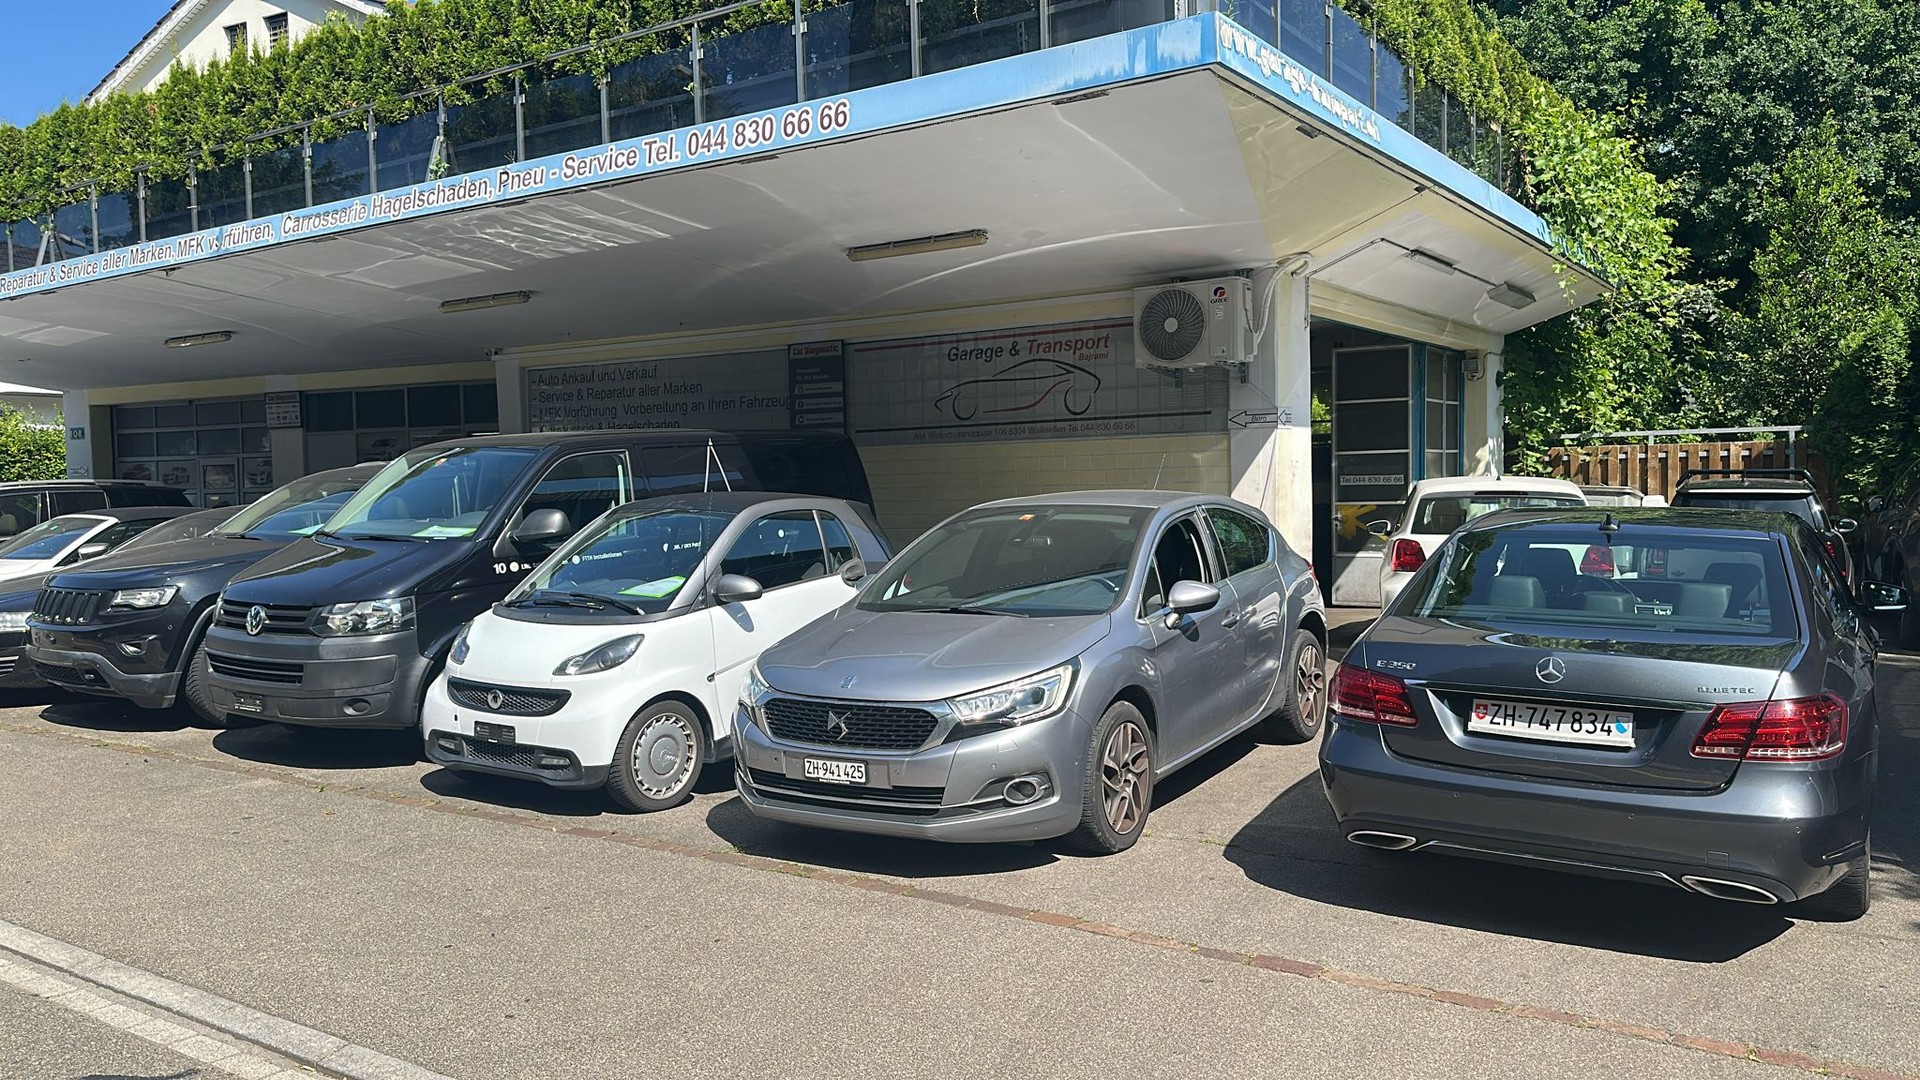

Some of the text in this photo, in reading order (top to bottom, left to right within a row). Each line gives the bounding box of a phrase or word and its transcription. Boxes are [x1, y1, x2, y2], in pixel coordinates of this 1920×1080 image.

[0, 269, 47, 294] Reparatur
[49, 268, 57, 283] &
[60, 260, 98, 281] Service
[102, 252, 127, 272] aller
[129, 245, 175, 266] Marken,
[177, 235, 204, 258] MFK
[208, 222, 274, 251] vrführen,
[283, 205, 366, 235] Carrosserie
[371, 179, 493, 218] Hagelschaden,
[498, 167, 544, 192] Pneu
[563, 148, 637, 179] Service
[644, 138, 679, 165] Tel.
[688, 126, 726, 156] 044
[734, 116, 774, 147] 830
[783, 109, 810, 137] 66
[819, 101, 848, 131] 66
[947, 333, 1110, 362] Garage & Transport
[538, 374, 560, 386] Auto
[561, 370, 595, 385] Ankauf
[597, 369, 616, 382] und
[618, 365, 658, 380] Verkauf
[539, 390, 574, 403] Service
[576, 388, 584, 401] &
[587, 386, 636, 402] Reparatur
[638, 384, 661, 396] aller
[663, 381, 703, 395] Marken
[564, 404, 617, 419] Vorführung
[623, 401, 688, 416] Vorbereitung
[691, 401, 704, 411] an
[708, 397, 736, 411] Ihren
[493, 562, 507, 574] 10
